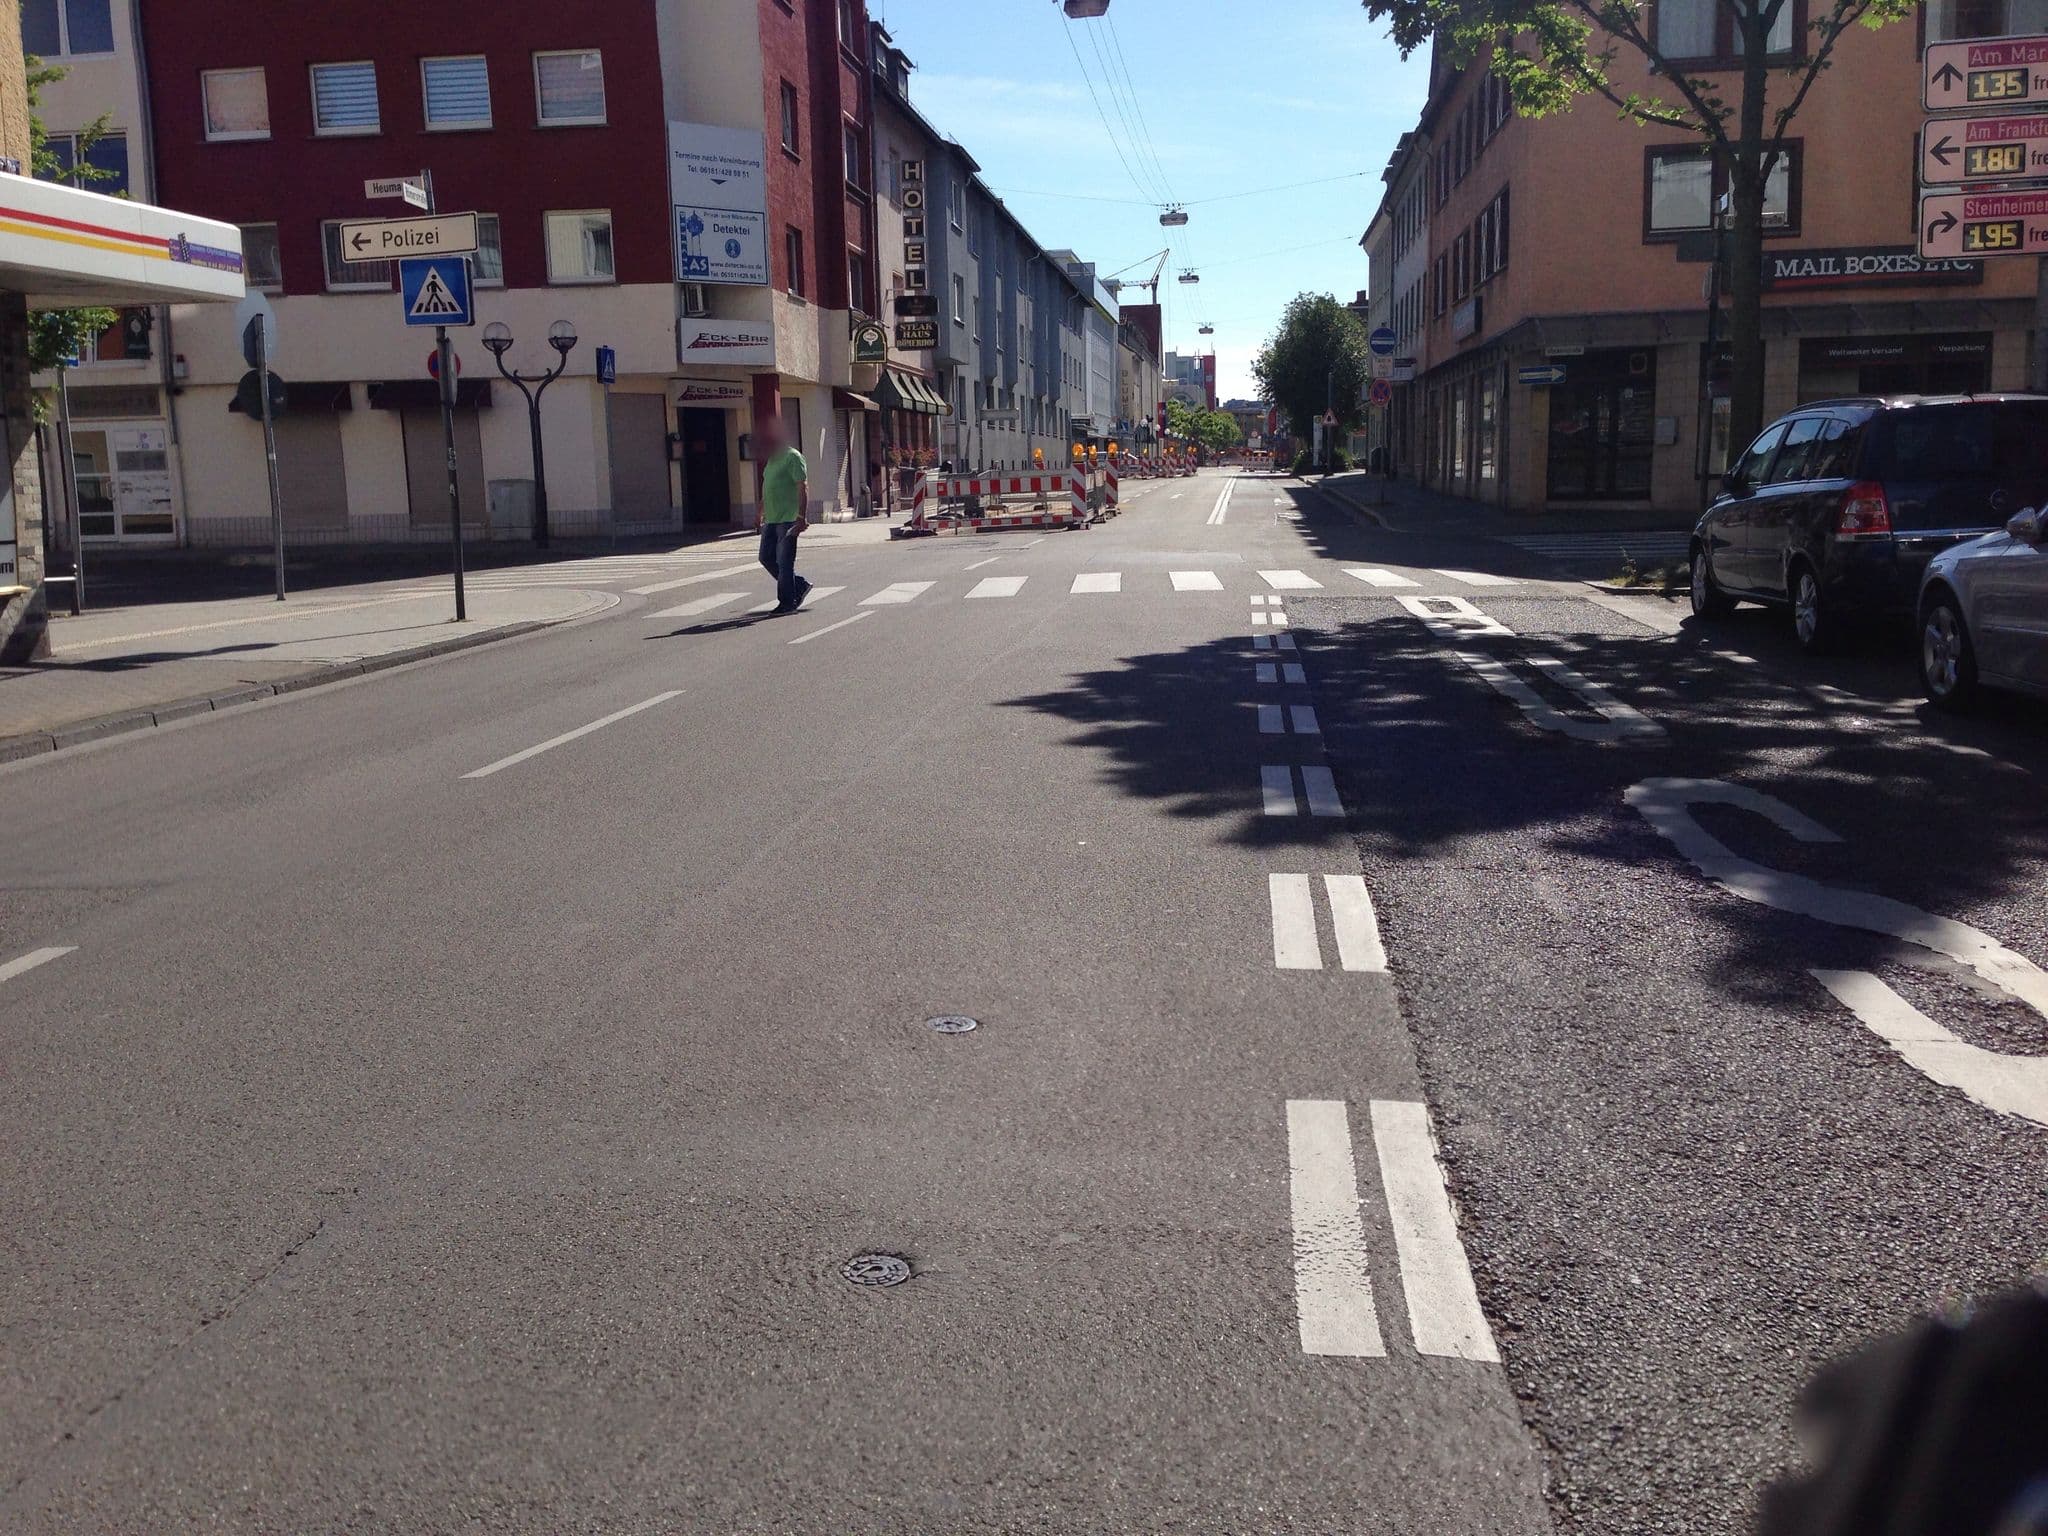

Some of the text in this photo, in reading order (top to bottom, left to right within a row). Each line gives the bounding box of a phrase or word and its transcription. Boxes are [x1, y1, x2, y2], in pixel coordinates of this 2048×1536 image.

[1971, 49, 2002, 64] Am
[1973, 71, 2022, 99] 135
[2034, 75, 2048, 90] fr
[1968, 125, 1990, 140] Am
[1971, 147, 2020, 173] 180
[713, 223, 750, 236] Detektei
[904, 162, 923, 288] HOTEL
[382, 227, 440, 248] Polizei
[1969, 224, 2017, 249] 195
[689, 258, 707, 271] AS
[1774, 257, 1842, 277] MAIL
[1844, 254, 1921, 274] BOXES
[900, 323, 933, 331] STEAK
[1872, 345, 1903, 355] Versand
